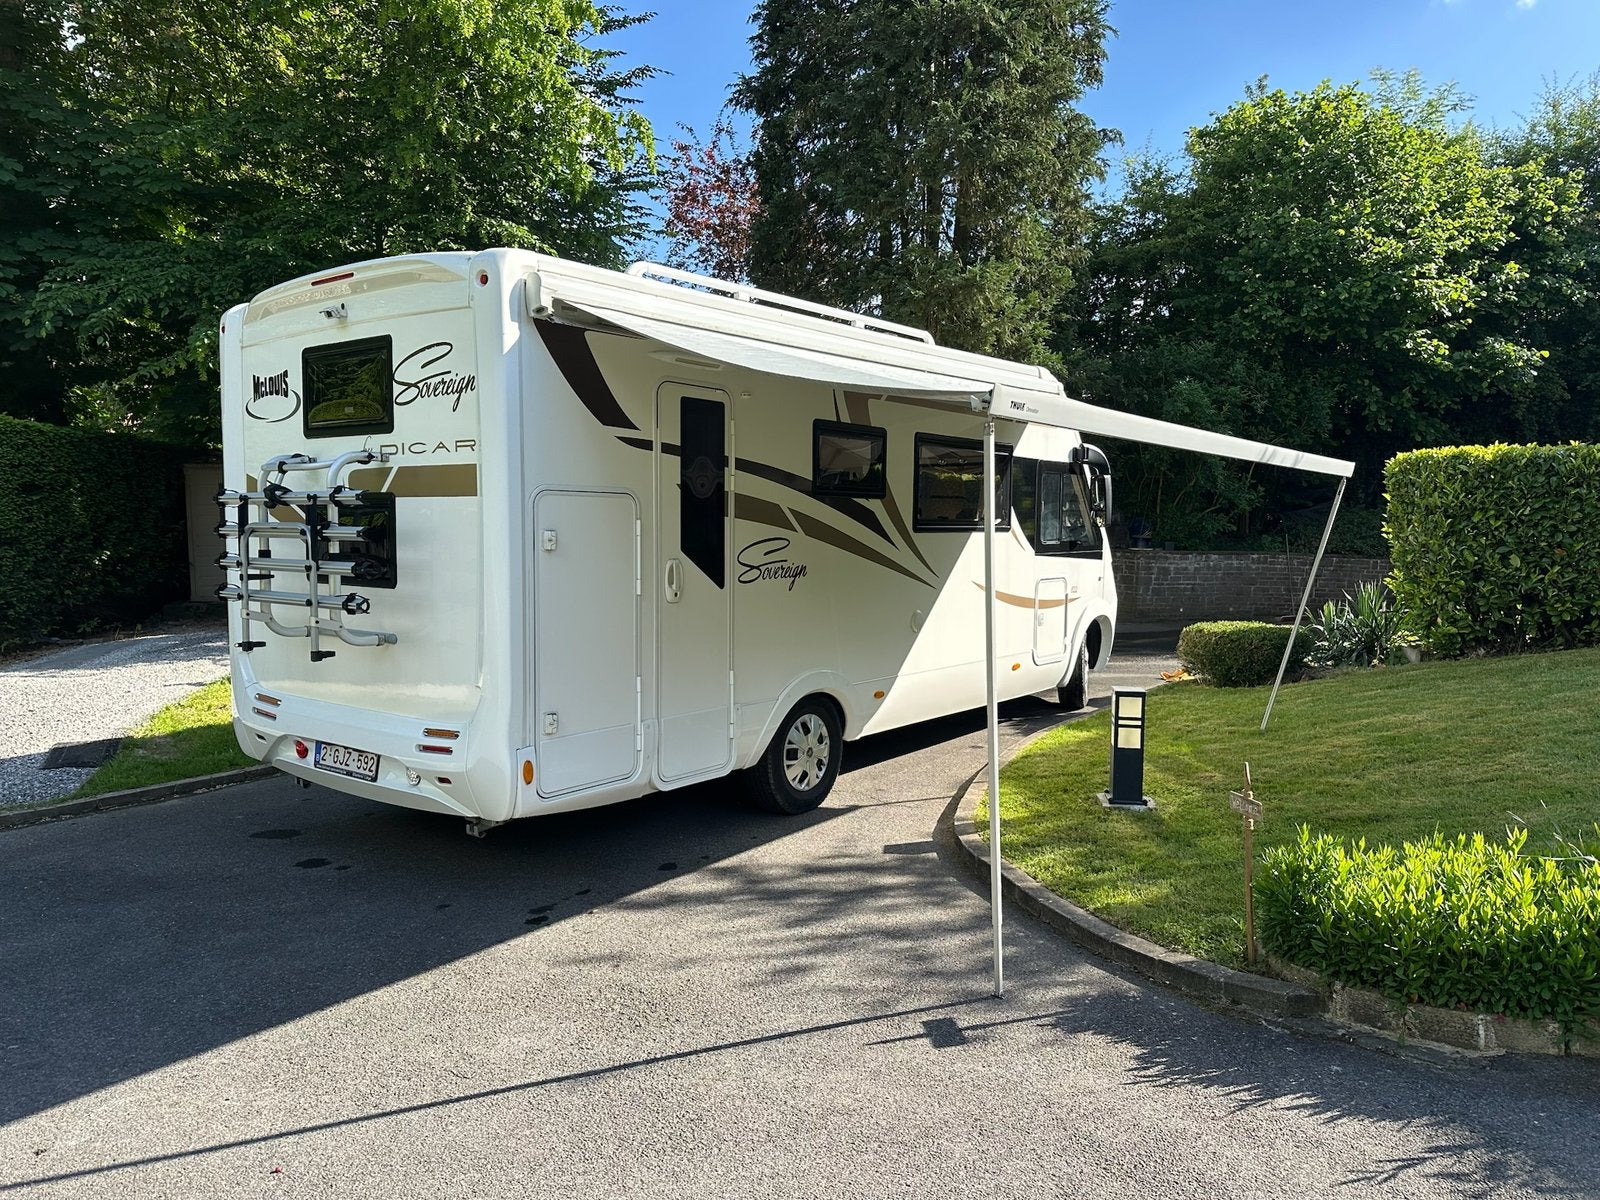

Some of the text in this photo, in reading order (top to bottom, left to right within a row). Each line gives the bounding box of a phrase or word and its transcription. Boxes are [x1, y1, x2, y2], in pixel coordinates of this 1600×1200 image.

[252, 369, 289, 403] McLOUIS
[393, 342, 476, 412] Sovereign
[737, 537, 807, 591] Sovereign
